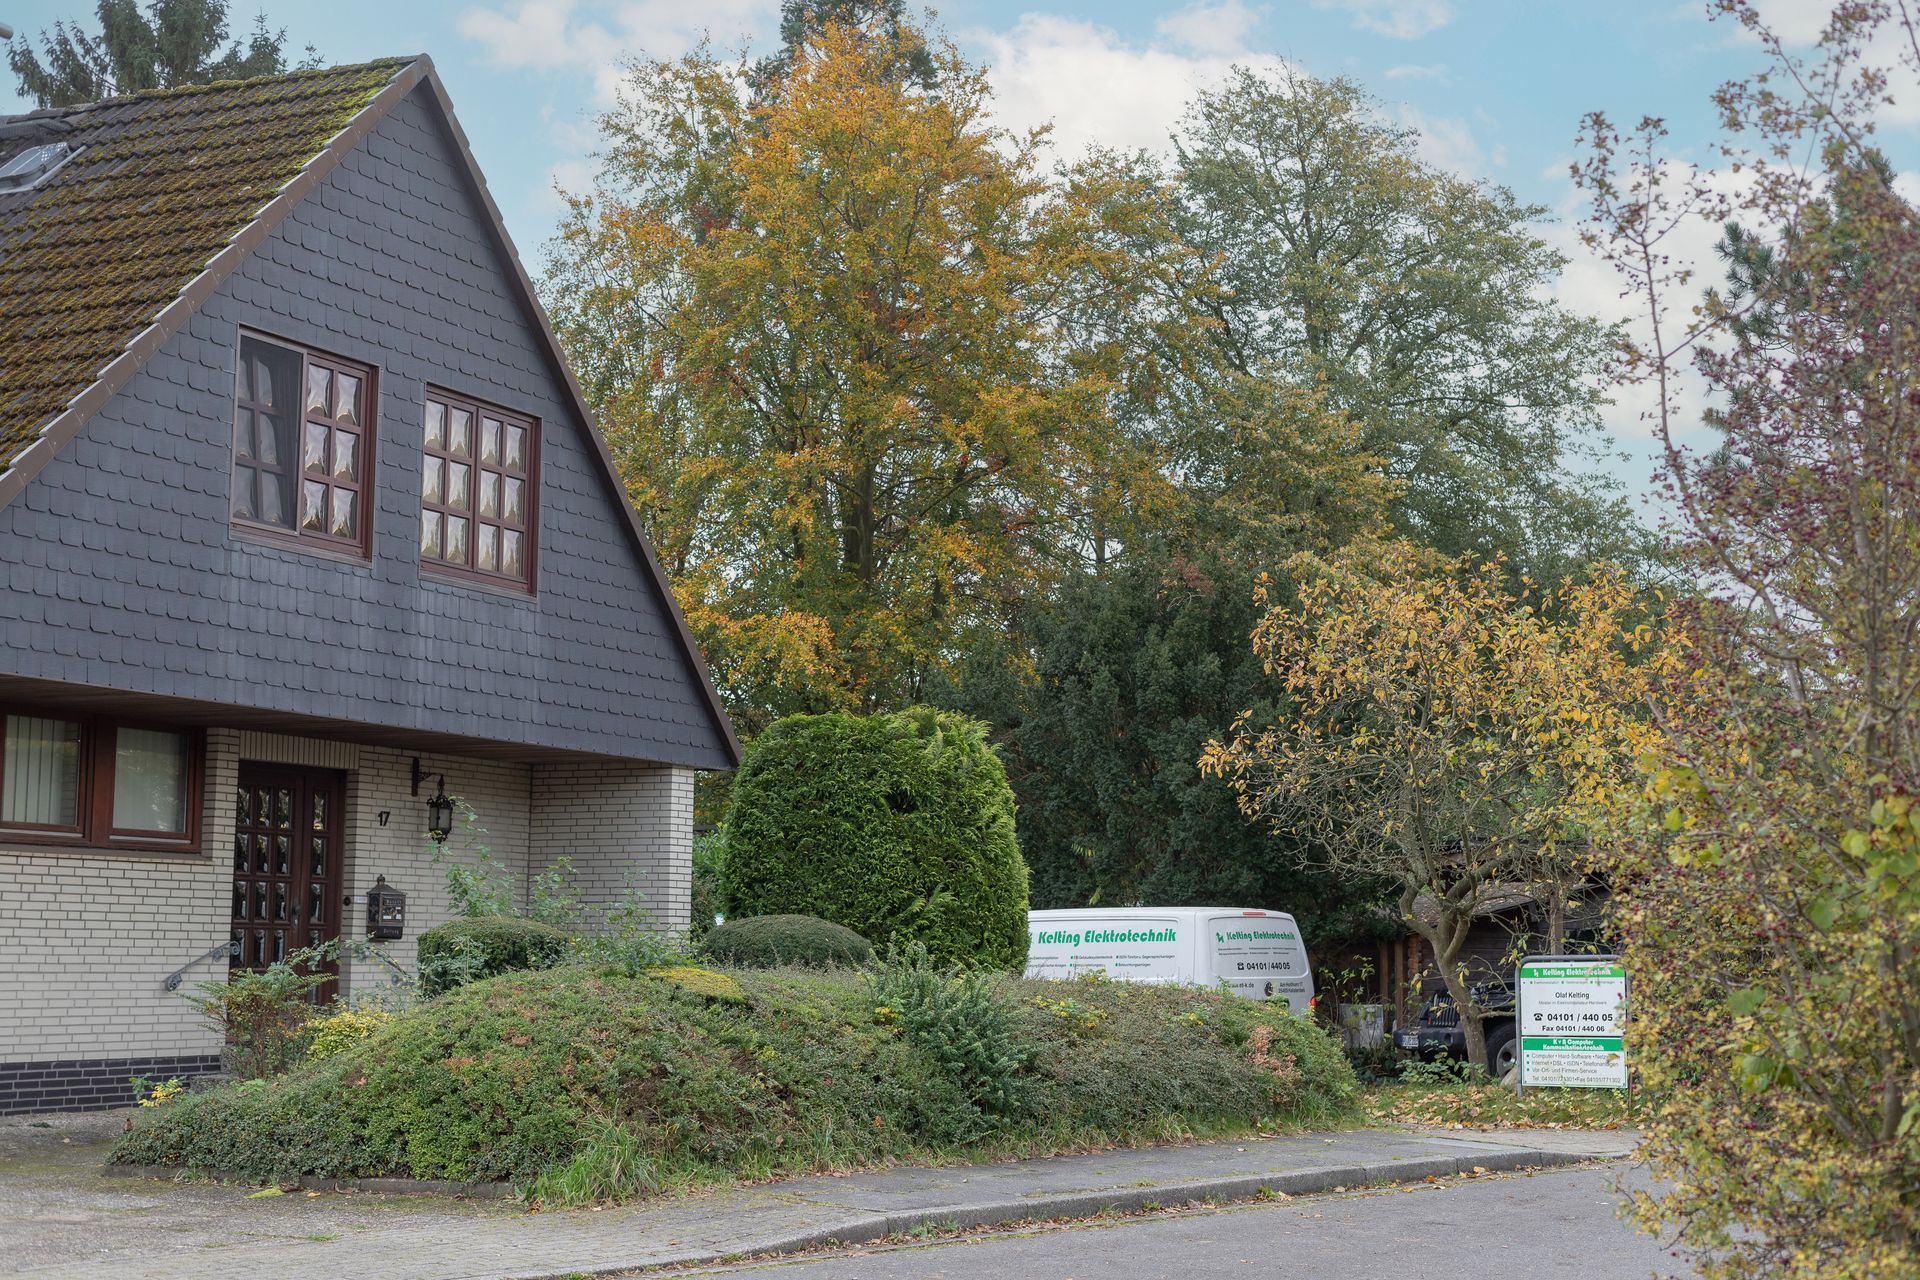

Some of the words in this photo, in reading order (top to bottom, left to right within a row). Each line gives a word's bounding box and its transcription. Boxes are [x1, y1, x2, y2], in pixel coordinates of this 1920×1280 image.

[378, 810, 391, 827] 17
[1038, 930, 1081, 947] Kelting
[1084, 928, 1177, 943] Elektrotechnik
[1226, 931, 1253, 941] Kelting
[1253, 931, 1296, 941] Elektrotechnik
[1542, 968, 1565, 978] Kelting
[1555, 991, 1568, 999] Olaf
[1568, 991, 1590, 1000] Kelting
[1547, 1013, 1574, 1022] 04101
[1577, 1013, 1580, 1022] /
[1582, 1013, 1599, 1022] 440
[1602, 1013, 1613, 1022] 05
